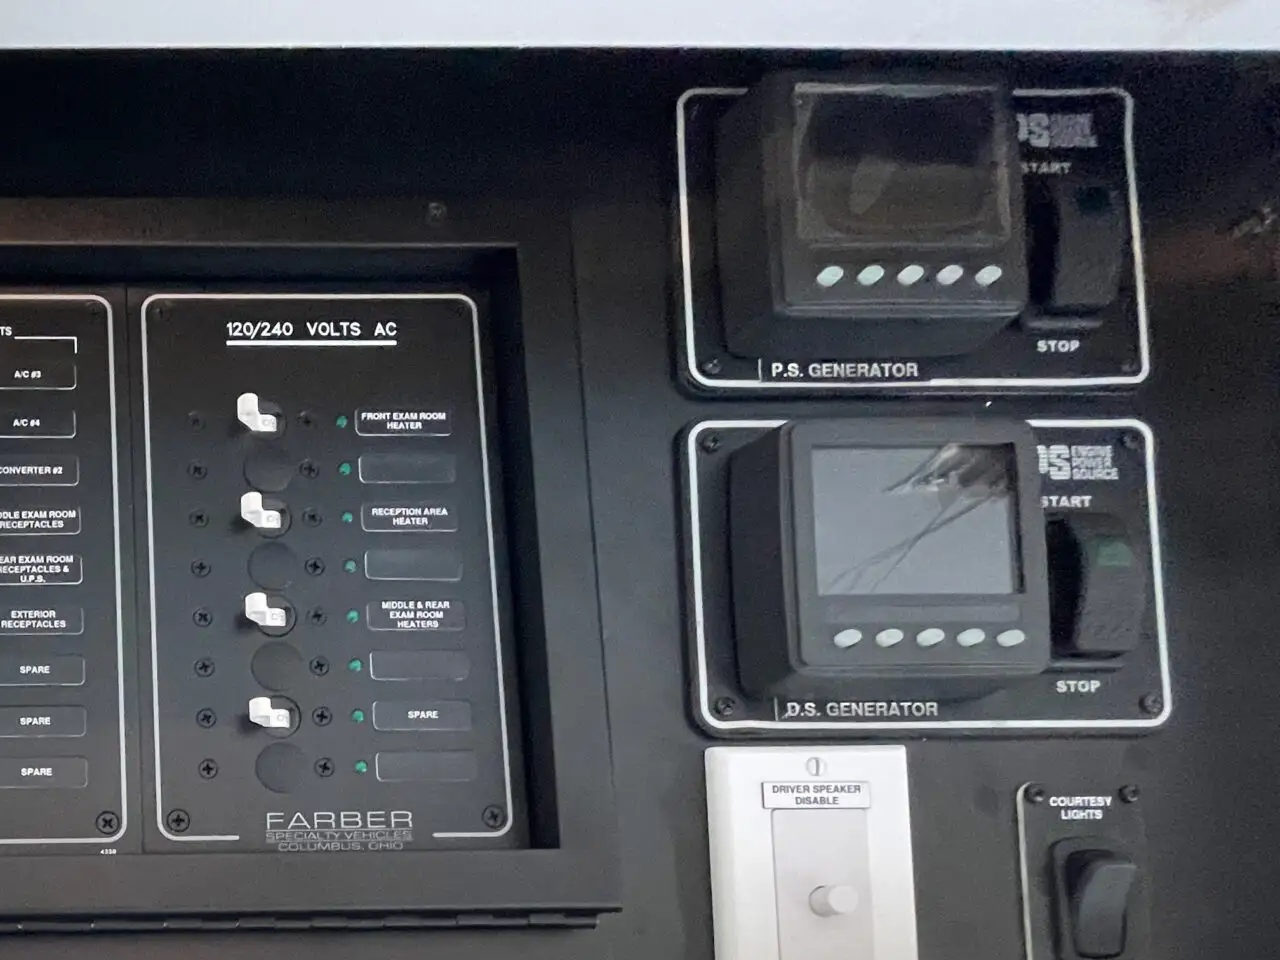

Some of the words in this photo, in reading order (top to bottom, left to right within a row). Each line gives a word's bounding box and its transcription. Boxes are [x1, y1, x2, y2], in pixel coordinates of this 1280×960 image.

[226, 322, 293, 338] 120/240
[307, 322, 361, 336] VOLTS
[374, 322, 397, 336] AC
[1037, 340, 1079, 352] STOP
[14, 370, 29, 378] A/C
[772, 363, 803, 377] P.S.
[809, 363, 918, 377] GENERATOR
[361, 413, 390, 421] FRONT
[393, 413, 417, 421] EXAM
[419, 412, 446, 420] ROOM
[13, 419, 28, 427] A/C
[387, 421, 422, 430] HEATER
[22, 511, 46, 519] EXAM
[49, 510, 76, 519] ROOM
[372, 508, 421, 516] RECEPTION
[423, 508, 448, 516] AREA
[0, 520, 64, 529] RECEPTACLES
[393, 517, 428, 526] HEATER
[19, 556, 44, 564] EXAM
[46, 555, 73, 564] ROOM
[62, 565, 69, 573] &
[381, 601, 415, 609] MIDDLE
[426, 601, 450, 609] REAR
[11, 611, 56, 619] EXTERIOR
[389, 611, 414, 619] EXAM
[416, 611, 443, 619] ROOM
[1, 620, 66, 628] RECEPTACLES
[397, 620, 438, 629] HEATERS
[19, 665, 50, 674] SPARE
[1056, 680, 1100, 693] STOP
[408, 710, 438, 719] SPARE
[786, 702, 821, 718] D.S.
[826, 702, 938, 717] GENERATOR
[20, 716, 51, 725] SPARE
[20, 768, 52, 776] SPARE
[772, 784, 811, 795] DRIVER
[814, 784, 861, 794] SPEAKER
[795, 796, 839, 806] DISABLE
[1049, 796, 1111, 807] COURTESY
[1061, 809, 1103, 820] LIGHTS
[266, 811, 412, 830] FARBER
[266, 831, 342, 841] SPECIALTY
[344, 830, 411, 840] VEHICLES
[278, 842, 364, 852] COLUMBUS,
[368, 841, 403, 851] OHIO
